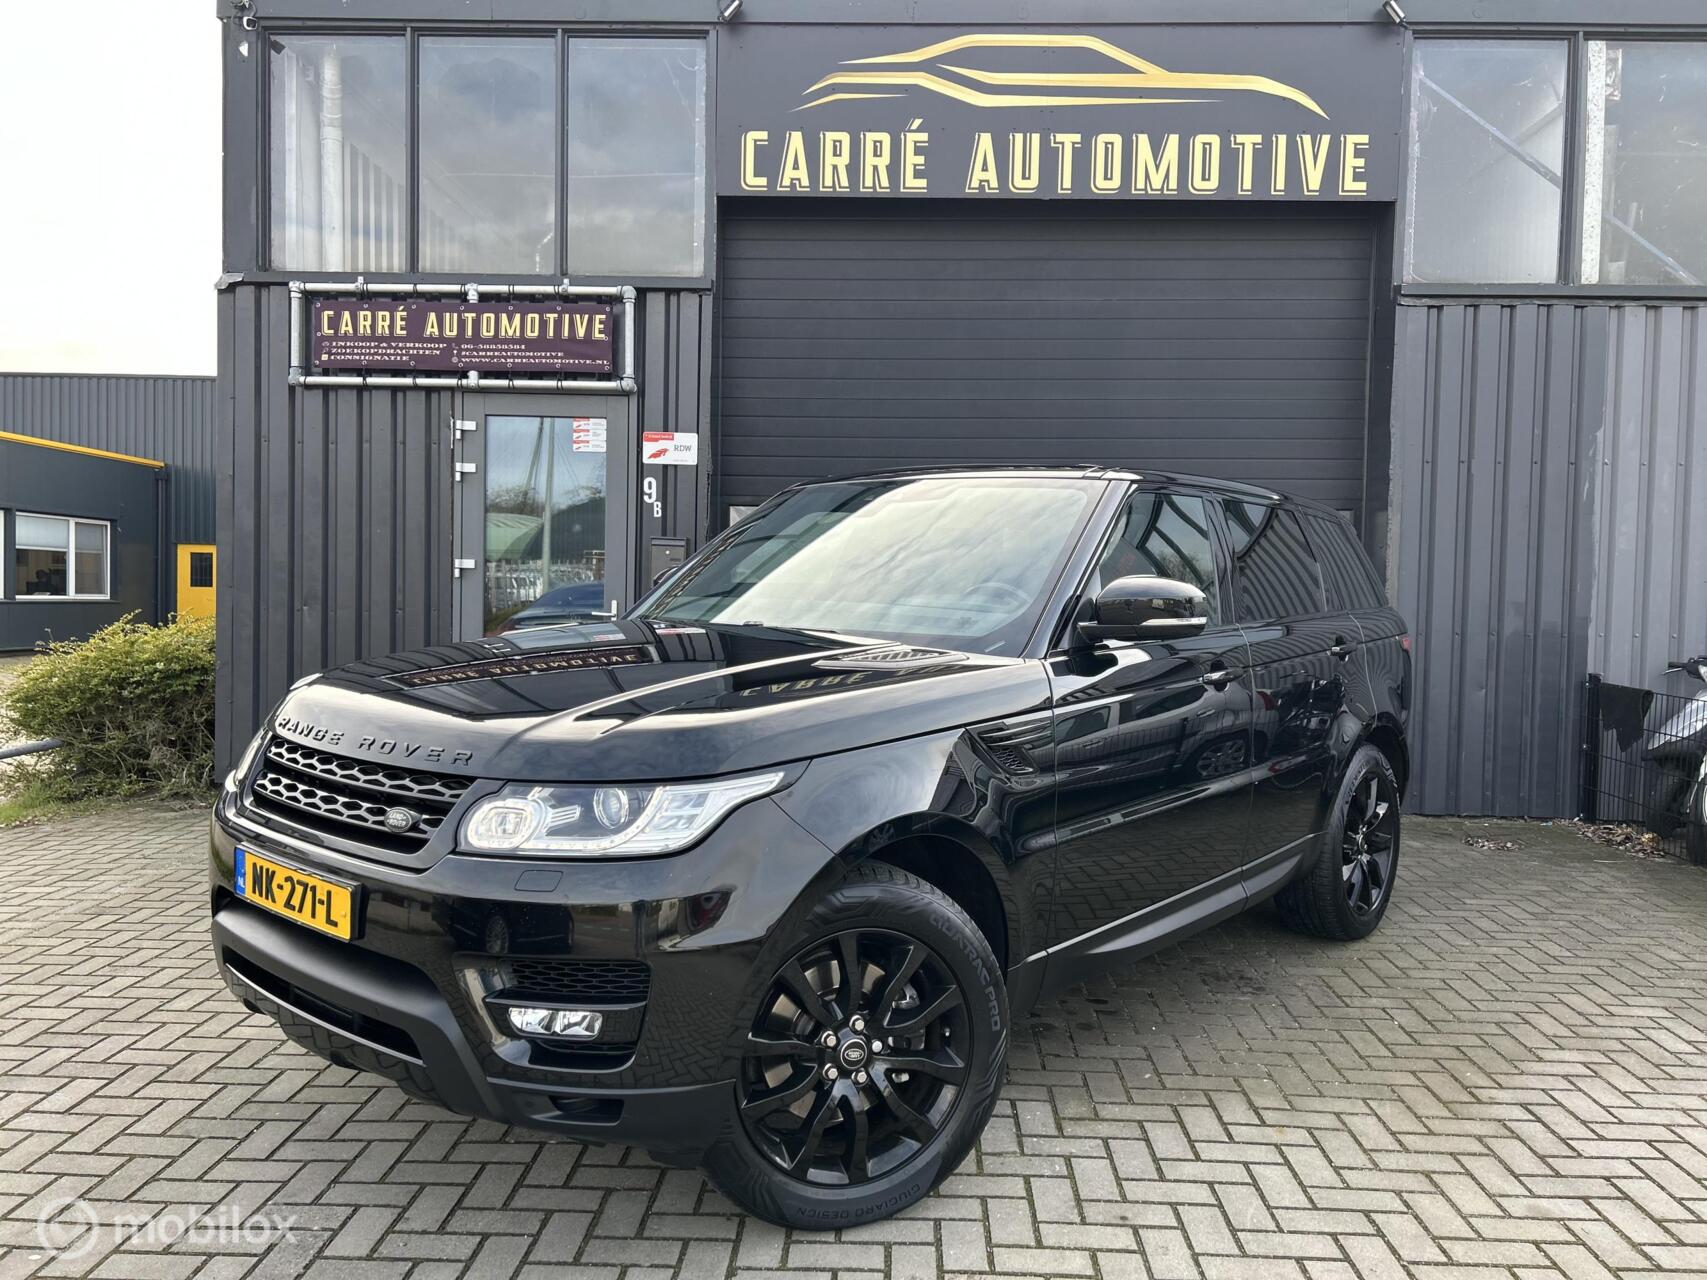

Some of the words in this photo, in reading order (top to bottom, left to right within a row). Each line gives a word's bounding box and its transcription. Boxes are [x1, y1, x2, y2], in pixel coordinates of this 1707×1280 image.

[741, 118, 929, 193] CARRÉ
[965, 132, 1370, 195] AUTOMOTIVE
[321, 306, 408, 337] CARRÉ
[423, 312, 607, 340] AUTOMOTIVE
[643, 476, 657, 504] 9
[653, 501, 662, 517] B
[278, 717, 344, 746] RANGE
[358, 735, 473, 767] ROVER
[252, 862, 339, 928] NK-271-L
[798, 1207, 849, 1219] DESIGN
